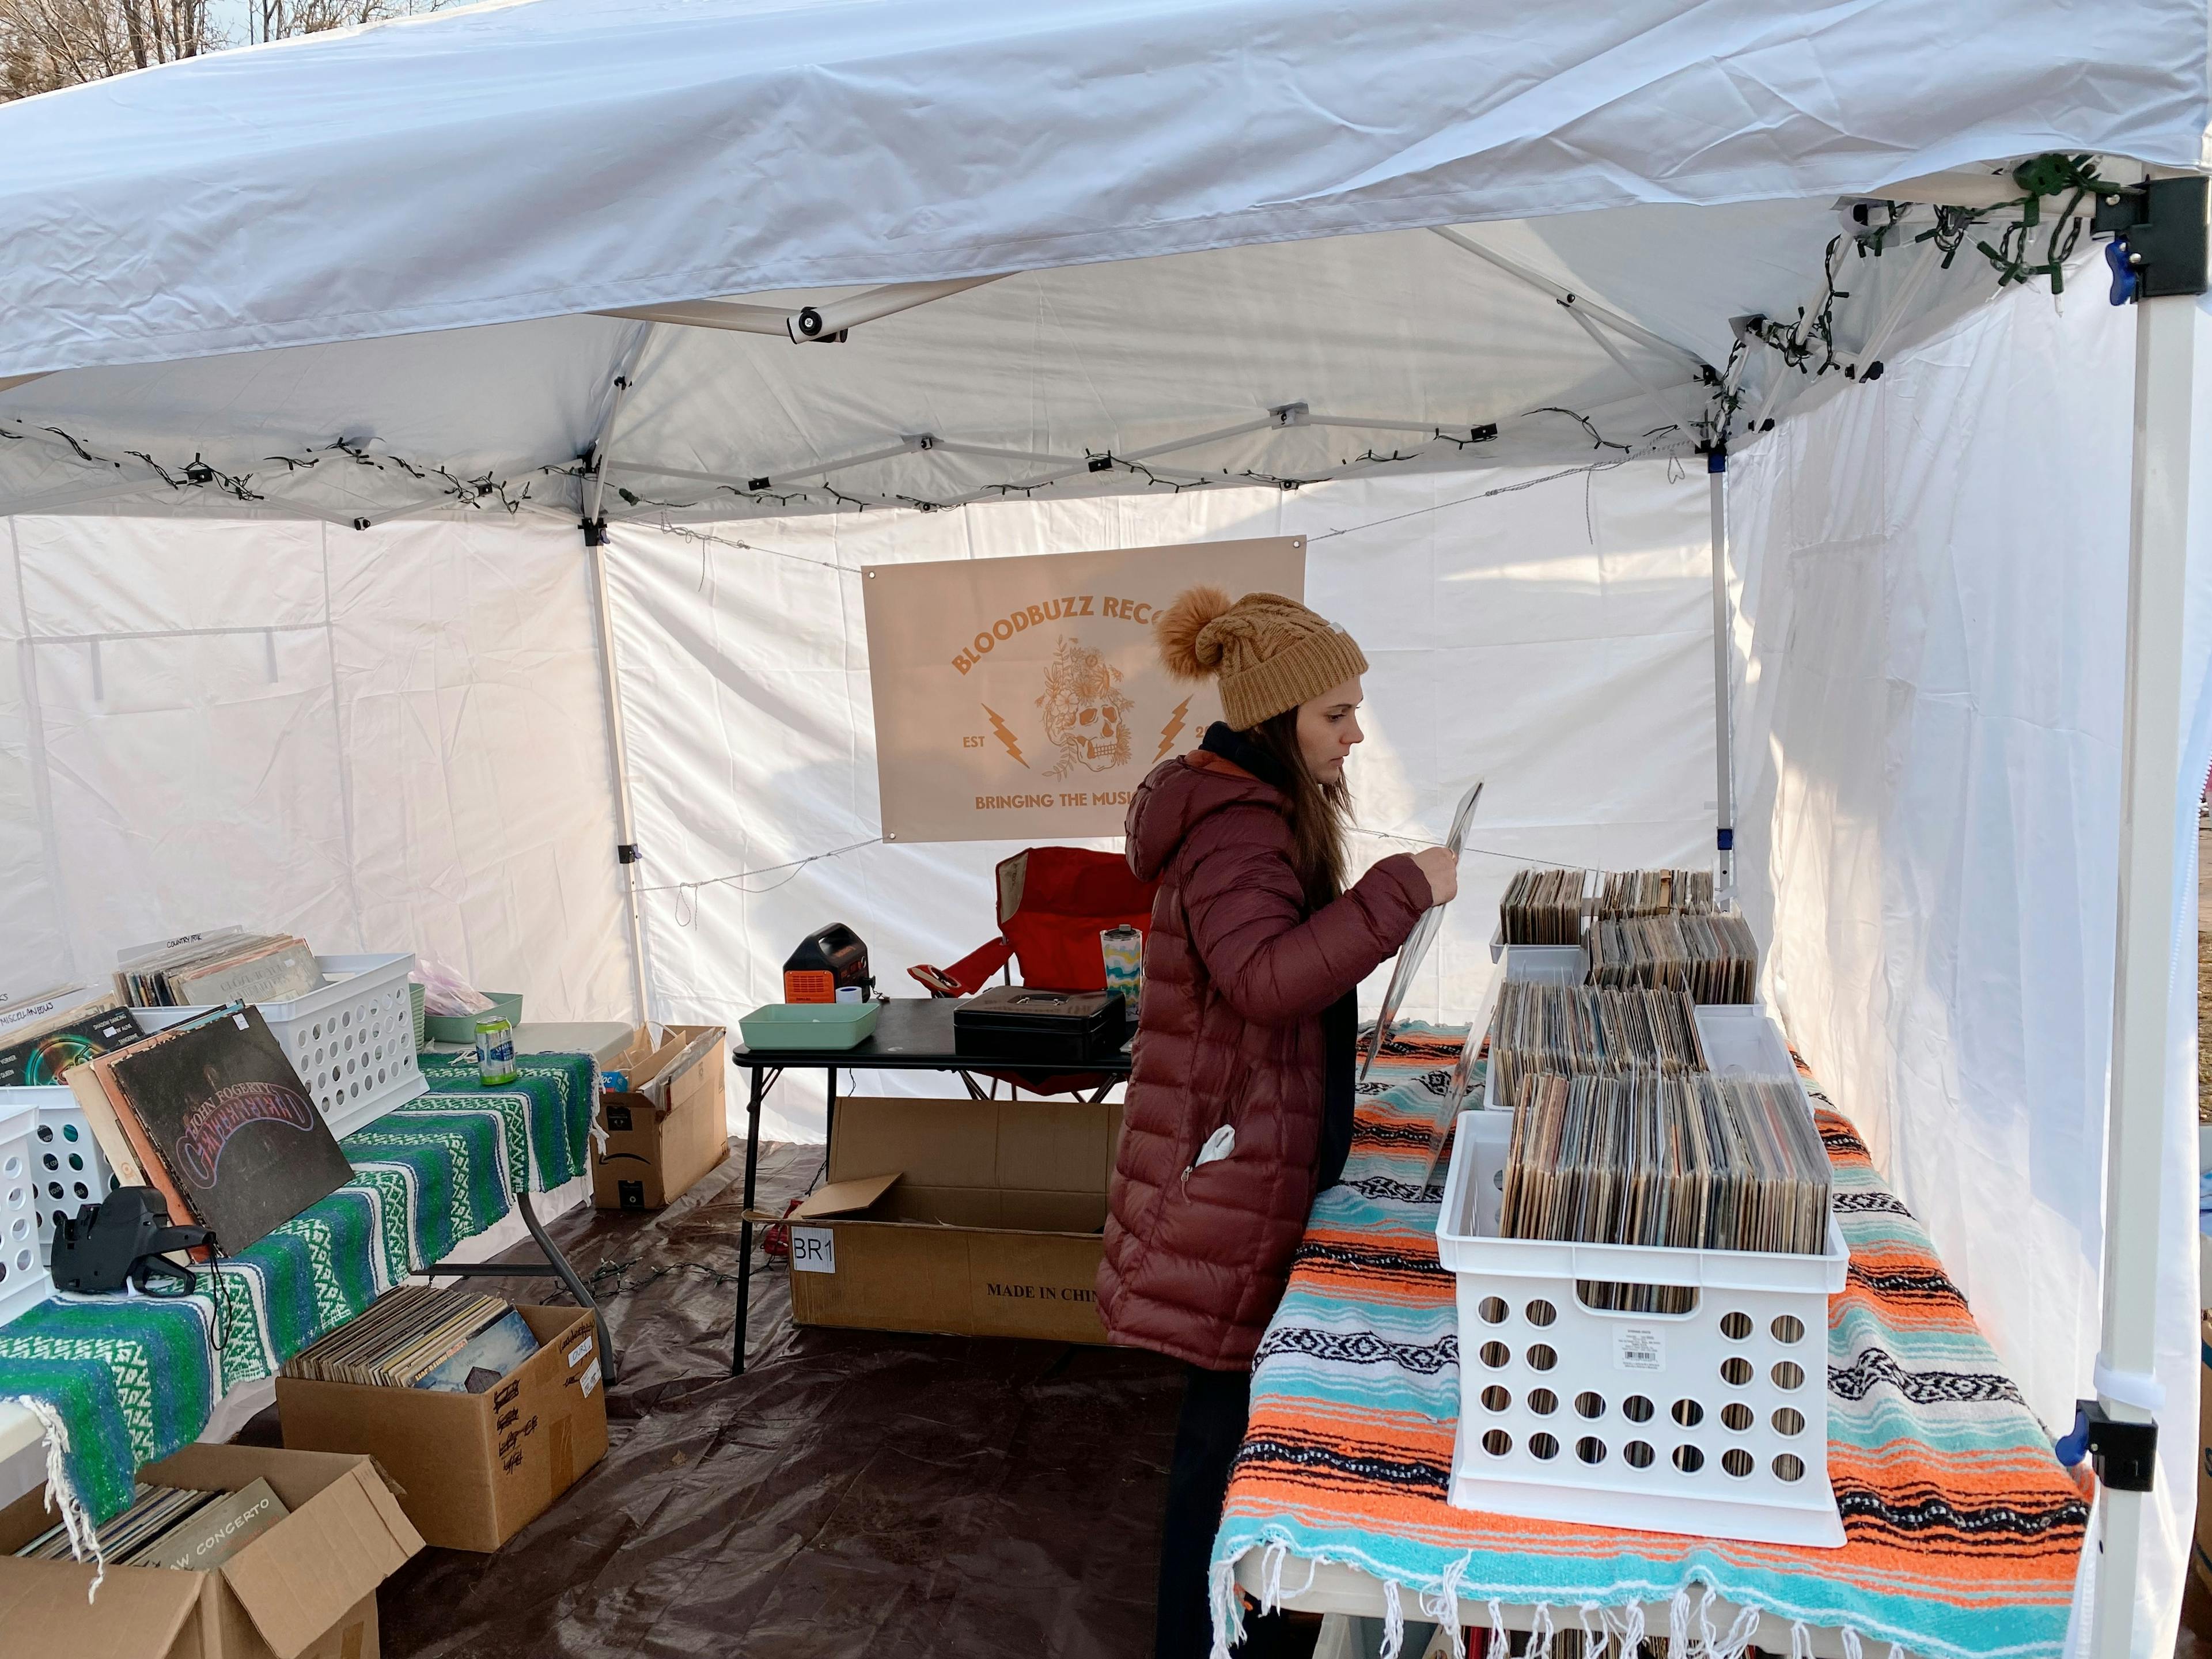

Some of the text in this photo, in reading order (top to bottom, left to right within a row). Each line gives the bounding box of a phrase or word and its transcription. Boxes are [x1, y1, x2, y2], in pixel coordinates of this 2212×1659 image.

[952, 596, 1094, 676] BLOODBUZZ
[963, 736, 985, 748] EST
[975, 794, 1054, 809] BRINGING
[1059, 793, 1087, 806] THE
[1, 1002, 54, 1027] MISCELLANEOUS
[190, 1082, 271, 1135] JOHN FOGERTY
[794, 1238, 832, 1262] BR1
[987, 1283, 1035, 1298] MADE
[1039, 1287, 1056, 1300] IN
[196, 1498, 270, 1555] CONCERTO
